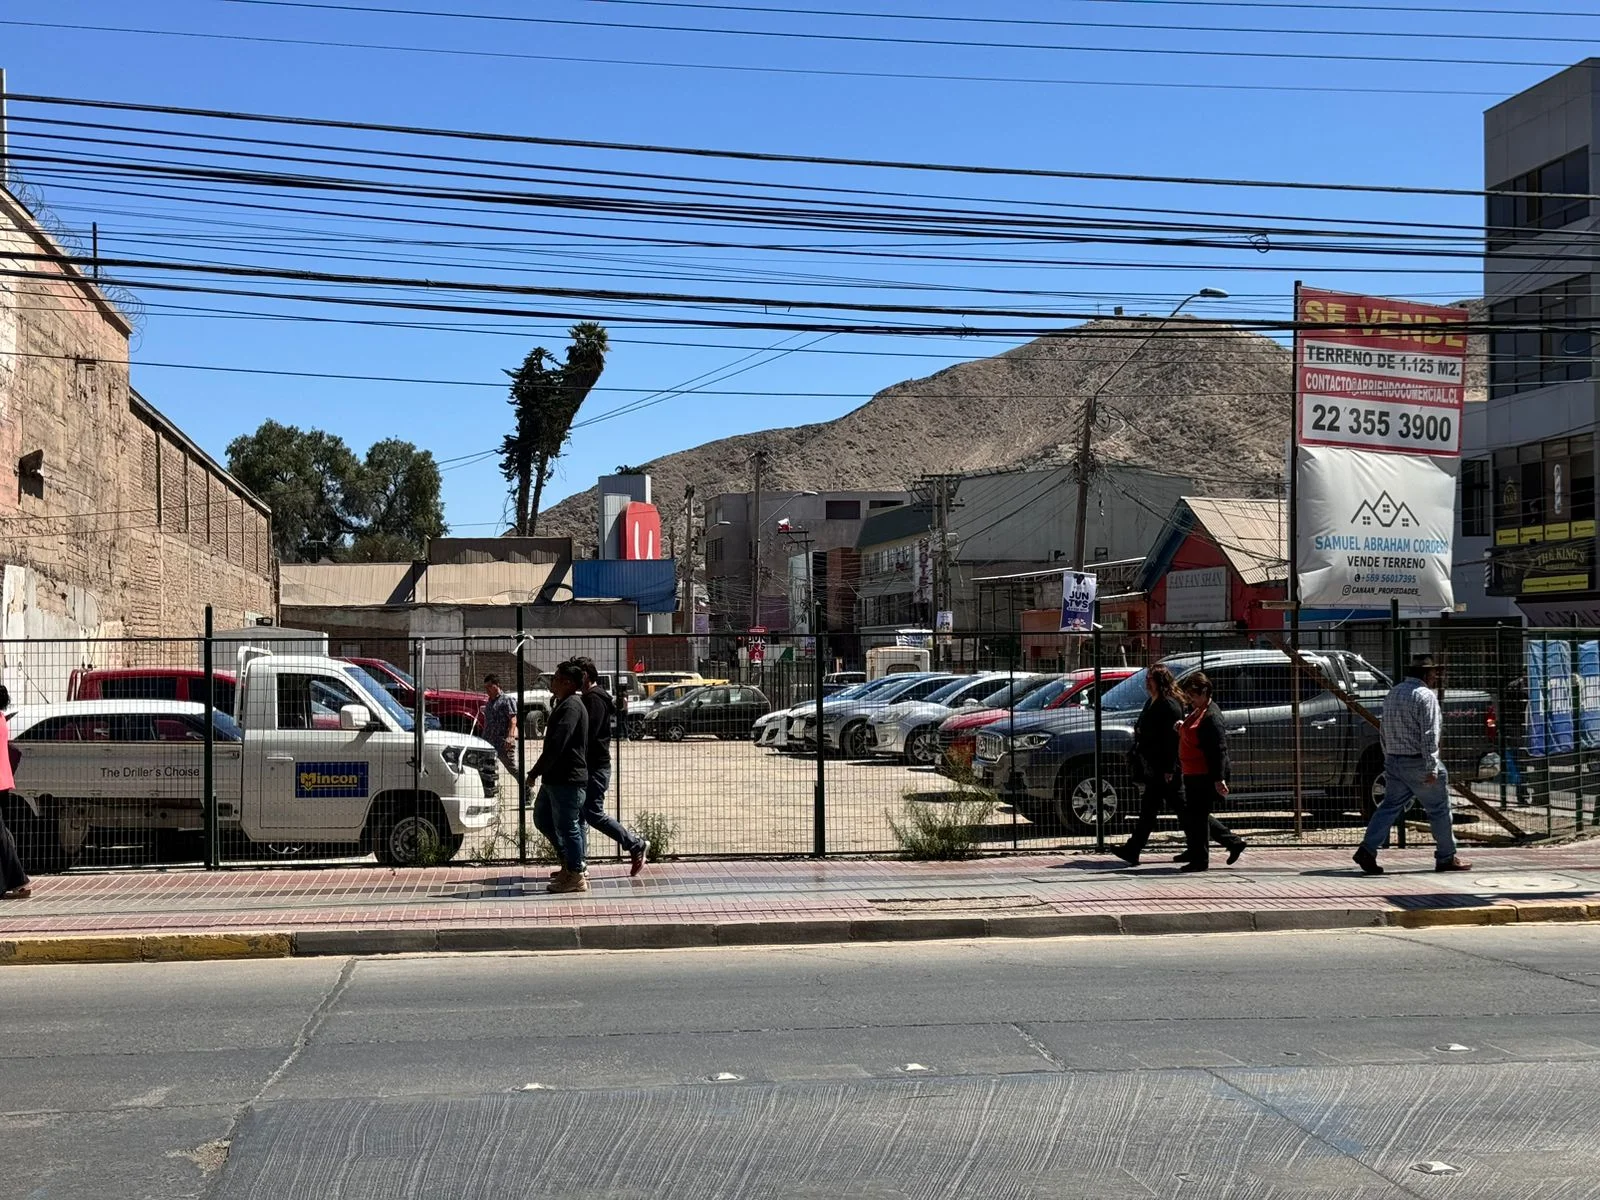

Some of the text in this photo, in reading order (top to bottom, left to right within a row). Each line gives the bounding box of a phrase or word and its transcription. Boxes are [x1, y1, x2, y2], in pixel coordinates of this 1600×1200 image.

[1305, 300, 1464, 347] SE VENDE
[1306, 344, 1372, 367] TERRENO
[1378, 353, 1395, 369] DE
[1400, 356, 1434, 373] 1.125
[1312, 404, 1451, 442] 22 355 3900
[1315, 535, 1360, 550] SAMUEL
[1364, 536, 1410, 552] ABRAHAM
[1347, 555, 1425, 569] VENDE TERRENO
[1536, 550, 1554, 566] THE
[1381, 573, 1416, 583] 56017395
[1069, 590, 1089, 600] JUN
[100, 766, 200, 777] The Driller's Choise
[300, 772, 358, 787] Mincon
